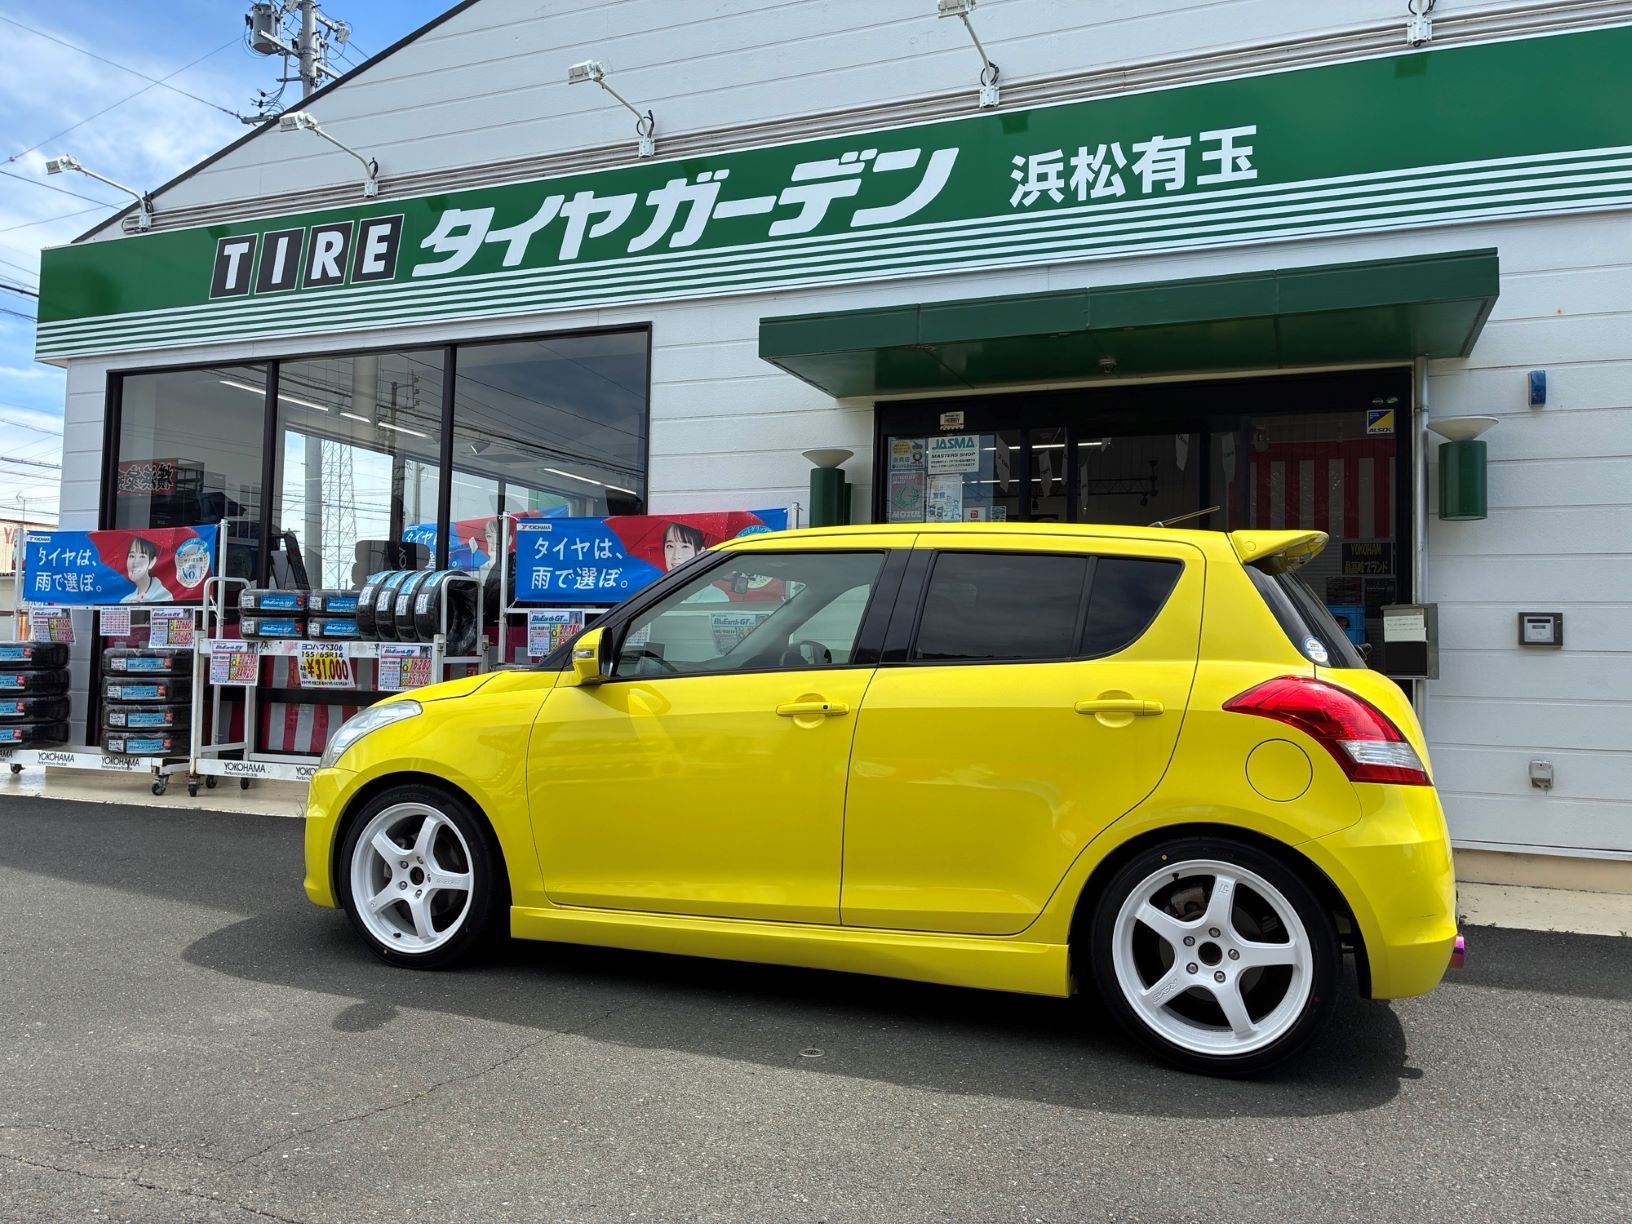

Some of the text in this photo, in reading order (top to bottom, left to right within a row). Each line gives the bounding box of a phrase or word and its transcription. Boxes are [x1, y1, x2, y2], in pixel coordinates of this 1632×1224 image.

[1009, 124, 1258, 209] 浜松有玉
[412, 147, 960, 277] タイヤガーデン
[223, 223, 393, 290] TIRE
[931, 437, 975, 450] JASMA
[38, 546, 97, 567] タイヤは、
[534, 537, 623, 561] タイヤは、
[1350, 543, 1383, 556] YOKOHAM
[35, 571, 102, 592] 雨で選ぼ。
[531, 566, 629, 590] 雨で選ぼ。
[301, 643, 343, 652] ヨコハマS306
[301, 651, 344, 659] 155/65R14
[306, 658, 349, 681] ¥31,000
[38, 752, 75, 763] YOKOHAMA
[101, 756, 140, 767] YOKOHAMA
[224, 762, 266, 773] YOKOHAMA
